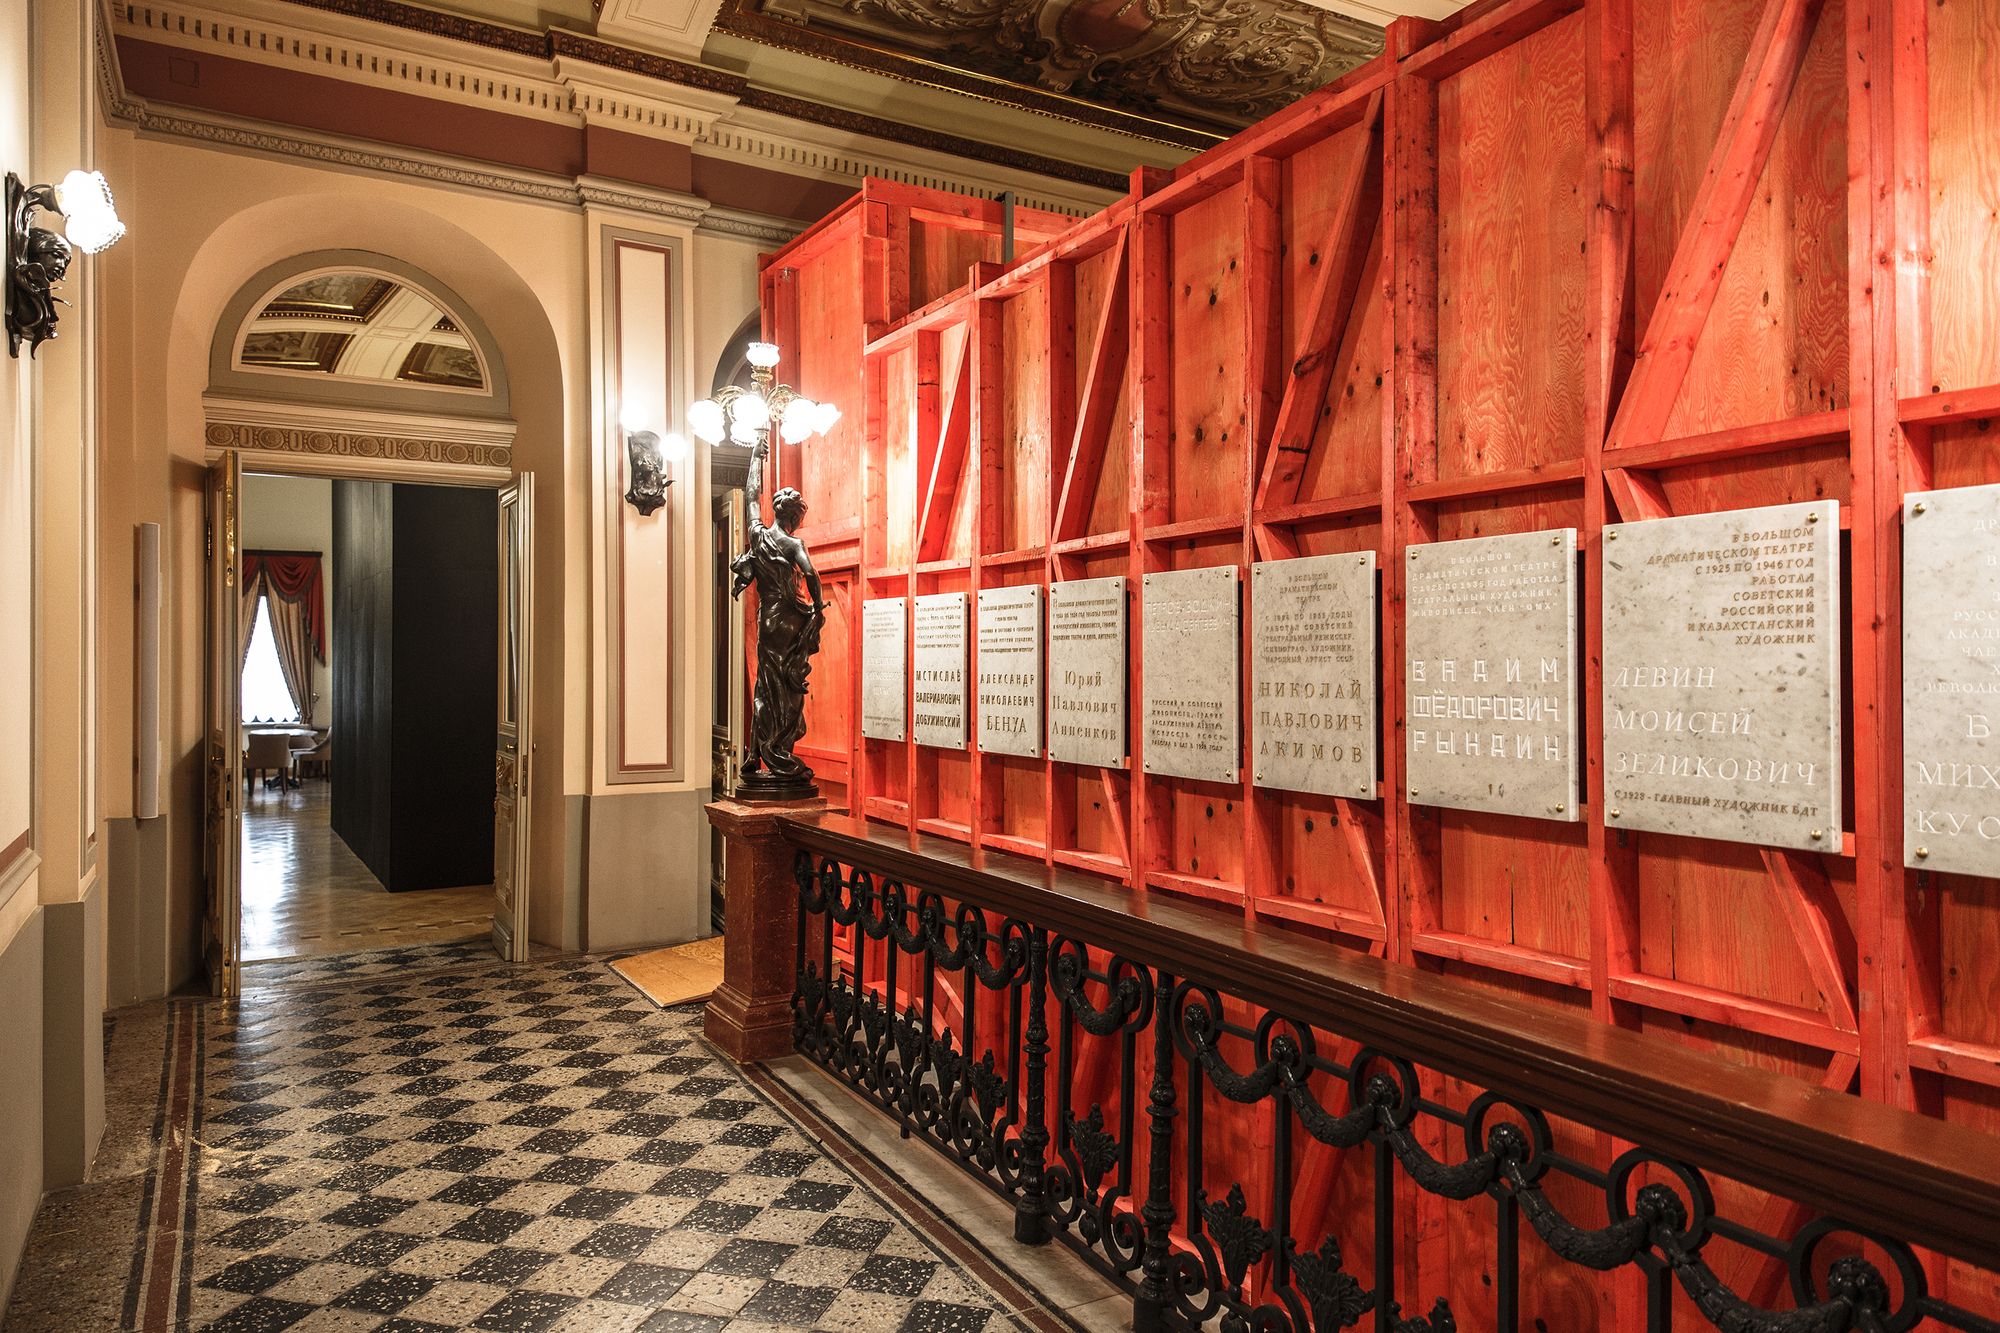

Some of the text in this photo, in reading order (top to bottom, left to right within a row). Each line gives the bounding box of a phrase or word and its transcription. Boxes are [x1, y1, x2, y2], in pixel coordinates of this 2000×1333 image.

[1973, 519, 2000, 532] ДР
[1732, 527, 1815, 543] В БОЛЬШОМ
[1460, 552, 1512, 564] БОЛЬШОМ
[1646, 541, 1815, 565] ДРАМАТИЧЕСКОМ ТЕАТРЕ
[1412, 561, 1558, 581] ДРАМАТИЧЕСКОМ ТЕАТРЕ
[1695, 557, 1815, 575] С 1925 ПО 1946 ГОД
[1446, 582, 1457, 590] ПО
[1487, 579, 1506, 587] ГОД
[1509, 575, 1558, 585] РАБОТАЛ
[1751, 573, 1815, 586] РАБОТАЛ
[1280, 583, 1338, 594] ДРАМАТИЧЕСКОМ
[1733, 587, 1815, 602] СОВЕТСКИЙ
[1412, 592, 1486, 605] ТЕАТРАЛЬНЫЙ
[1486, 605, 1515, 613] ЧЛЕН
[1721, 603, 1815, 616] РОССИЙСКИЙ
[1266, 621, 1353, 633] РАБОТАЛ СОВЕТСКИЙ
[1688, 618, 1815, 631] И КАЗАХСТАНСКИЙ
[1266, 633, 1312, 642] ТЕАТРАЛЬНЫЙ
[1735, 634, 1816, 646] ХУДОЖНИК
[1266, 655, 1301, 663] НАРОДНЫЙ
[1305, 655, 1332, 663] АРТИСТ
[1962, 647, 2000, 657] ЧЛЕ
[916, 670, 961, 682] МСТИСЛАВ
[1412, 657, 1560, 683] ВАДИМ
[1612, 666, 1717, 688] ЛЕВИН
[980, 673, 1035, 688] АЛЕКСАНДР
[1065, 670, 1102, 689] Юрий
[1260, 680, 1361, 699] НИКОЛАЙ
[916, 692, 961, 705] ВАЛЕРИАНОВИЧ
[980, 694, 1035, 707] НИКОЛАЕВИЧ
[1052, 695, 1117, 713] Павлович
[1413, 688, 1560, 722] ФЁДОРОВИЧ
[915, 714, 961, 728] ДОБУЖИНСКИЙ
[987, 715, 1027, 733] БЕНУА
[1260, 711, 1362, 731] ПАВЛОВИЧ
[1613, 708, 1752, 735] МОИСЕЙ
[1966, 714, 1991, 738] Б
[1052, 721, 1117, 741] Анненков
[1260, 741, 1362, 763] АКИМОВ
[1413, 729, 1561, 761] РЫНДИН
[1614, 751, 1819, 786] ЗЕЛИКОВИЧ
[1917, 761, 2000, 790] МИХ
[1614, 790, 1621, 798] С
[1654, 793, 1710, 807] ГЛАВНЫЙ
[1713, 798, 1789, 814] ХУДОЖНИК
[1792, 804, 1819, 817] БДТ
